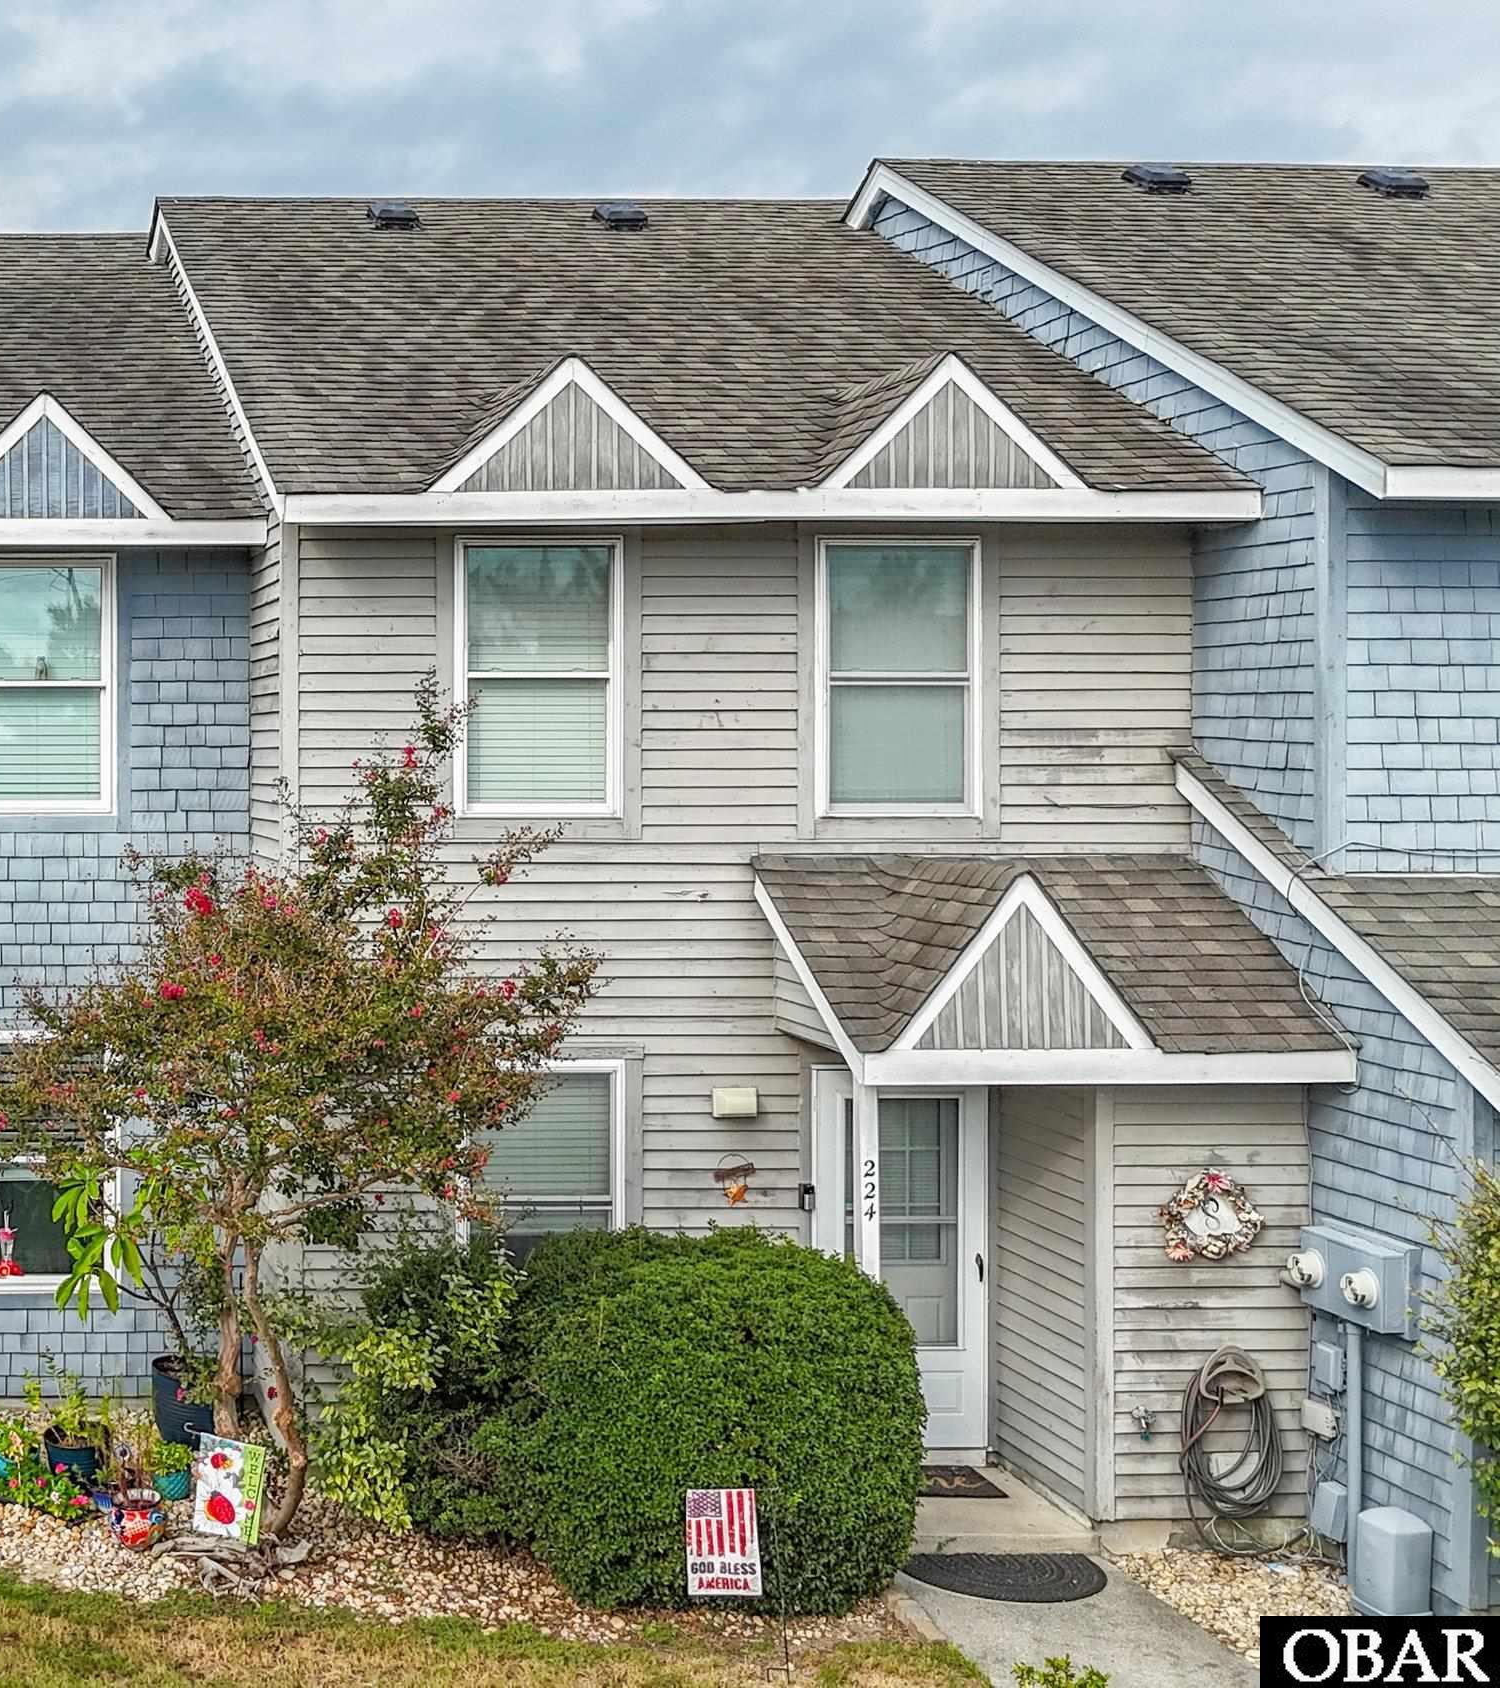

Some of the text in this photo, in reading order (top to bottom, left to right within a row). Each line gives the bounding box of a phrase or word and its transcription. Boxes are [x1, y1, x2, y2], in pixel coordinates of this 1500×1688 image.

[863, 1159, 877, 1222] 224
[1201, 1196, 1221, 1231] S
[690, 1561, 757, 1576] GOD BLESS
[697, 1576, 752, 1591] AMERICA
